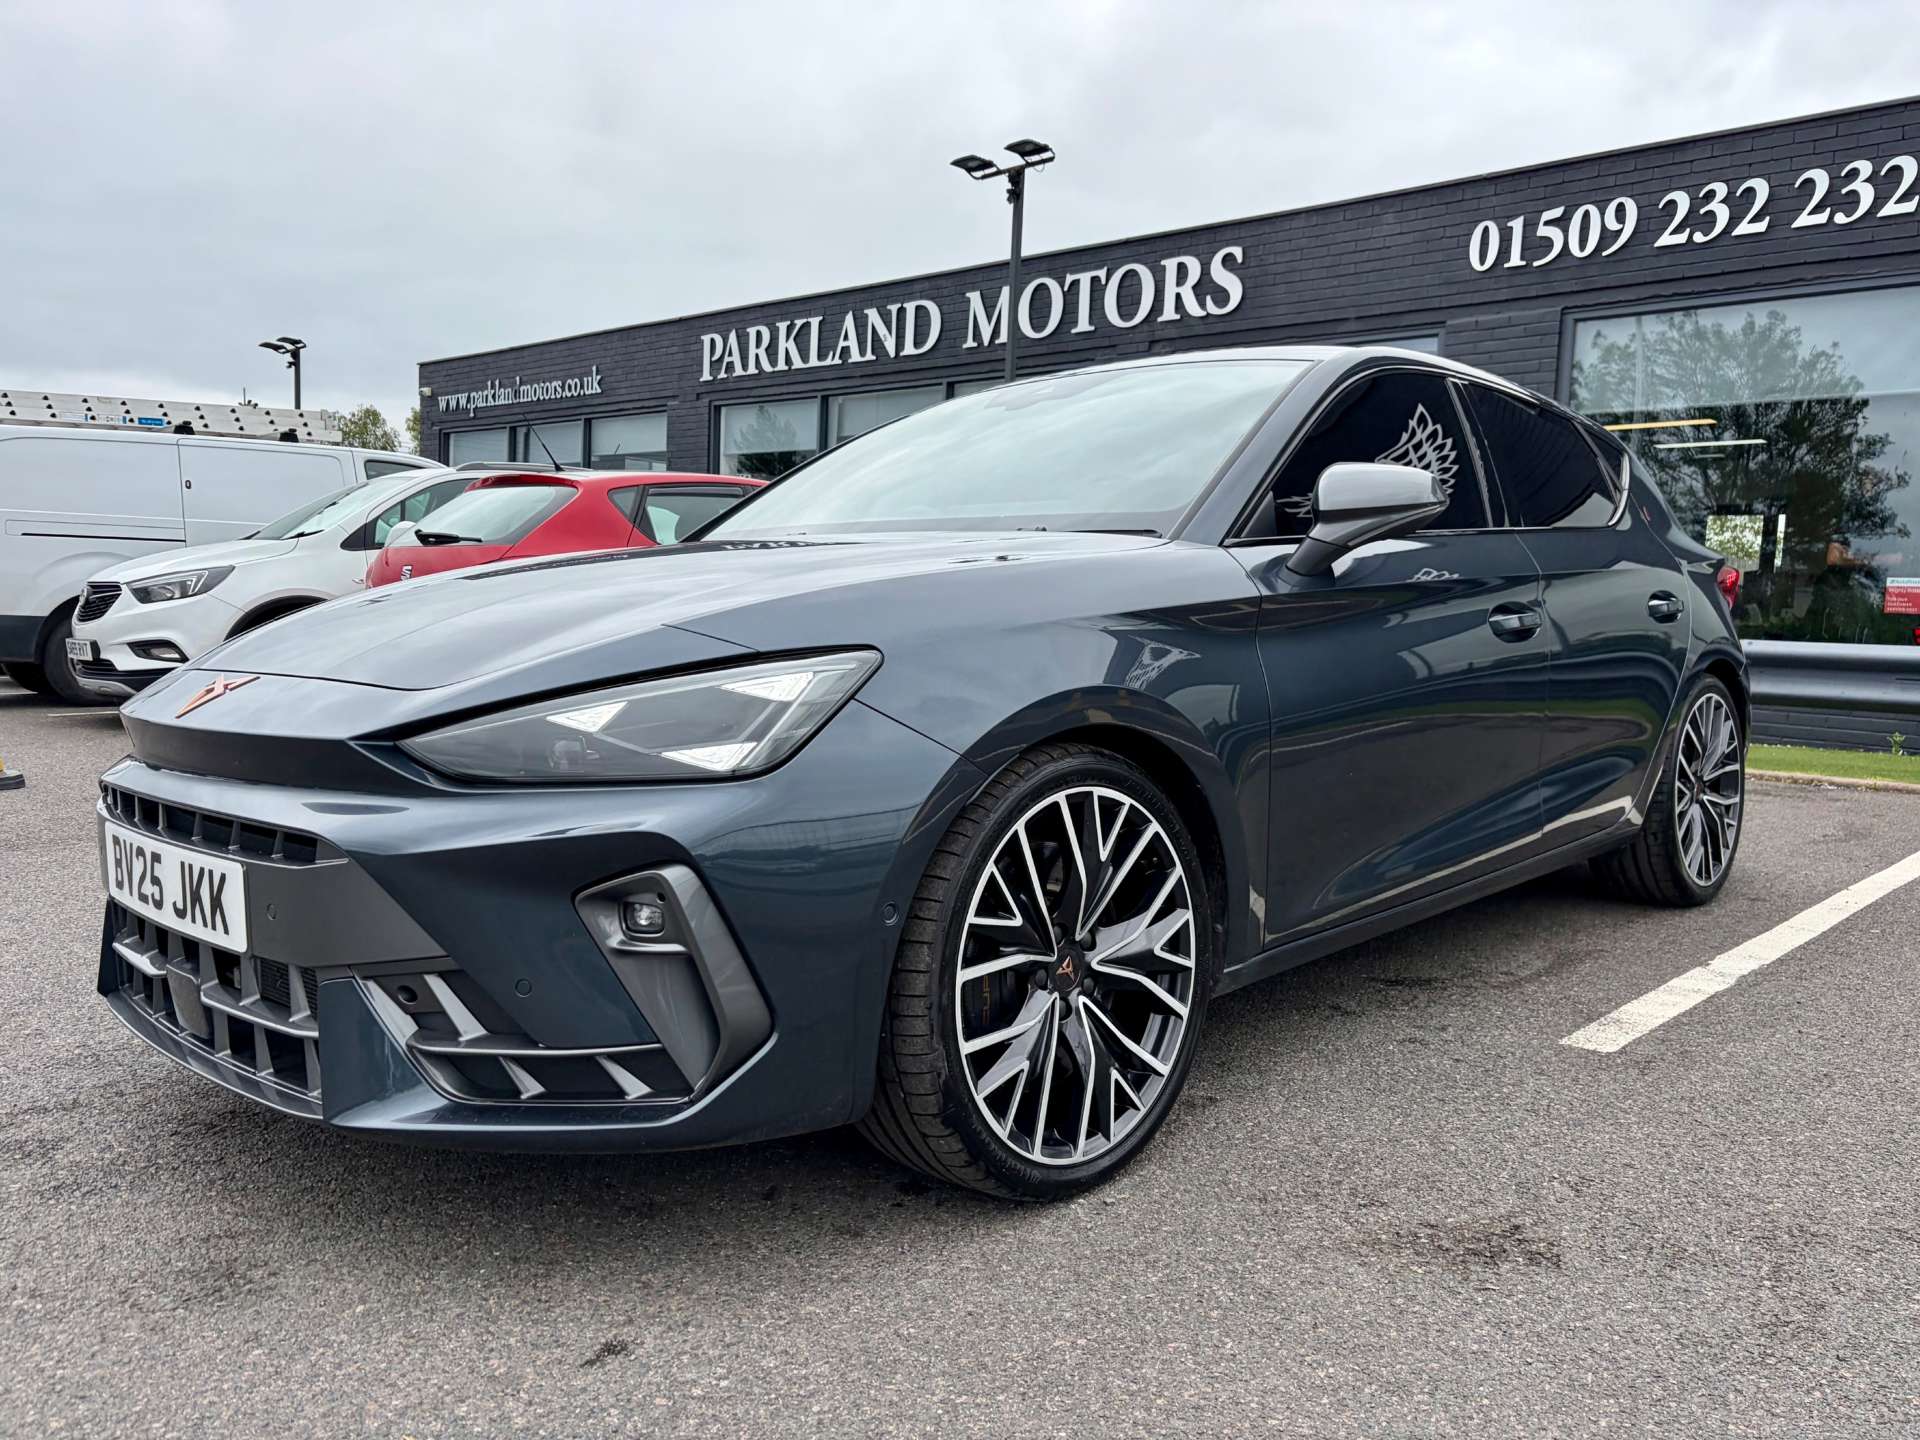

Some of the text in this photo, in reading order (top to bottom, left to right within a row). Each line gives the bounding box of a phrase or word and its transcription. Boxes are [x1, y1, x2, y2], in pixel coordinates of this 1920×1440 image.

[1468, 155, 1920, 272] 01509 232 232
[699, 246, 1245, 382] PARKLAND MOTORS
[438, 365, 602, 418] www.parklandmotors.co.uk
[111, 833, 230, 936] BV25 JKK
